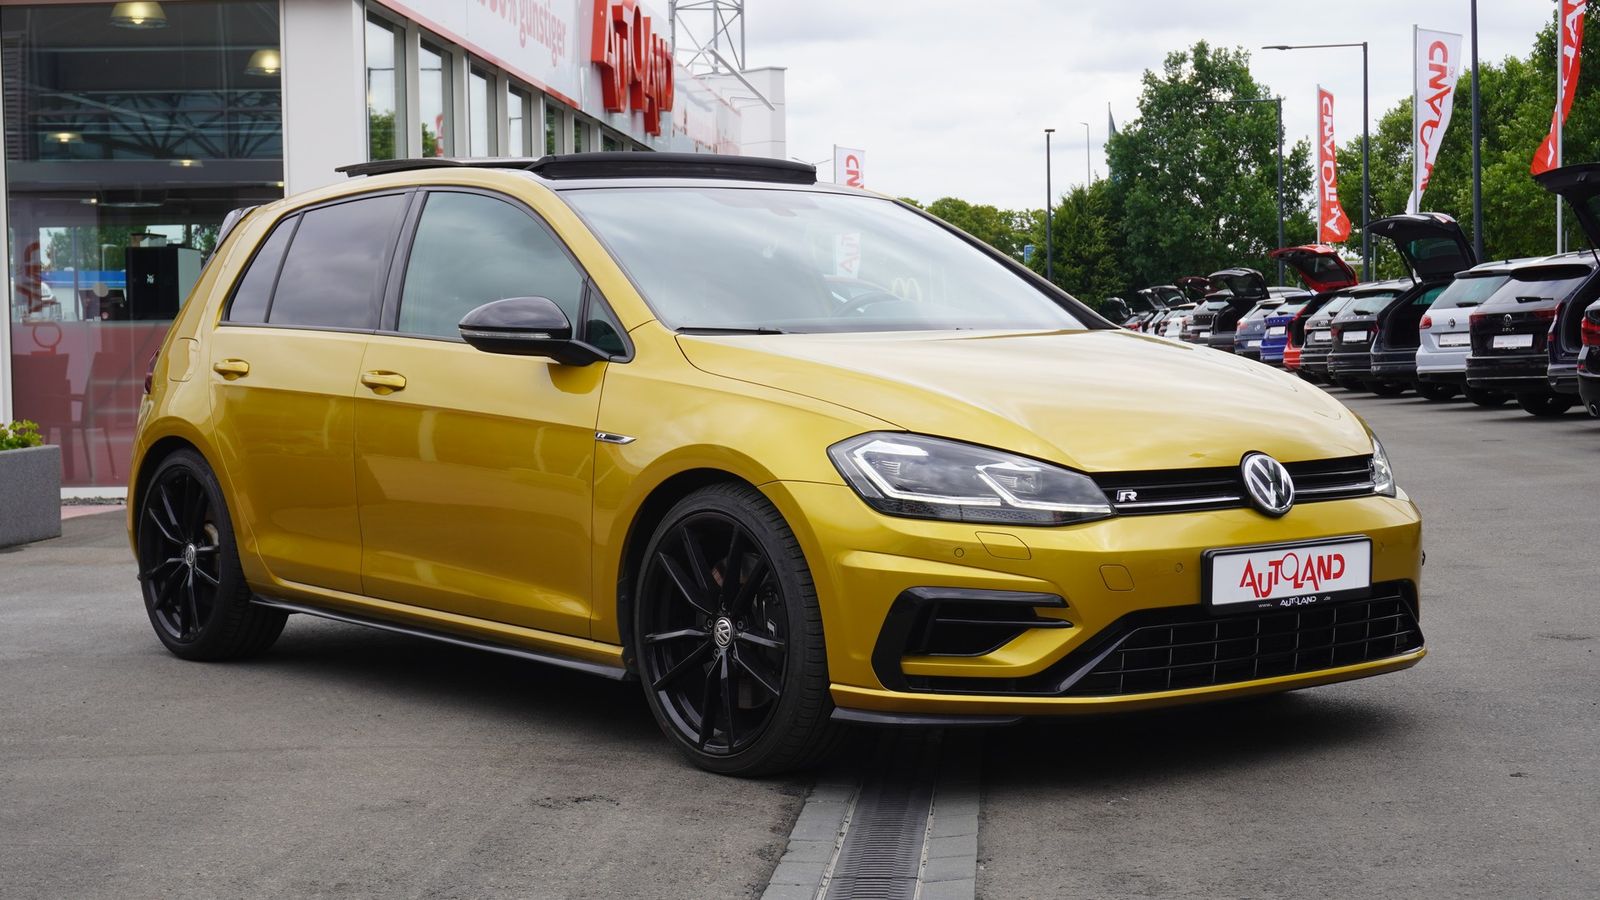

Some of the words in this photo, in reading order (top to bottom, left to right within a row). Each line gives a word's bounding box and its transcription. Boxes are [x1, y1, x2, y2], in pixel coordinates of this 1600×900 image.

[1117, 489, 1138, 502] R
[1239, 552, 1346, 598] AUTOLAND
[1280, 595, 1317, 607] AUTOLAND
